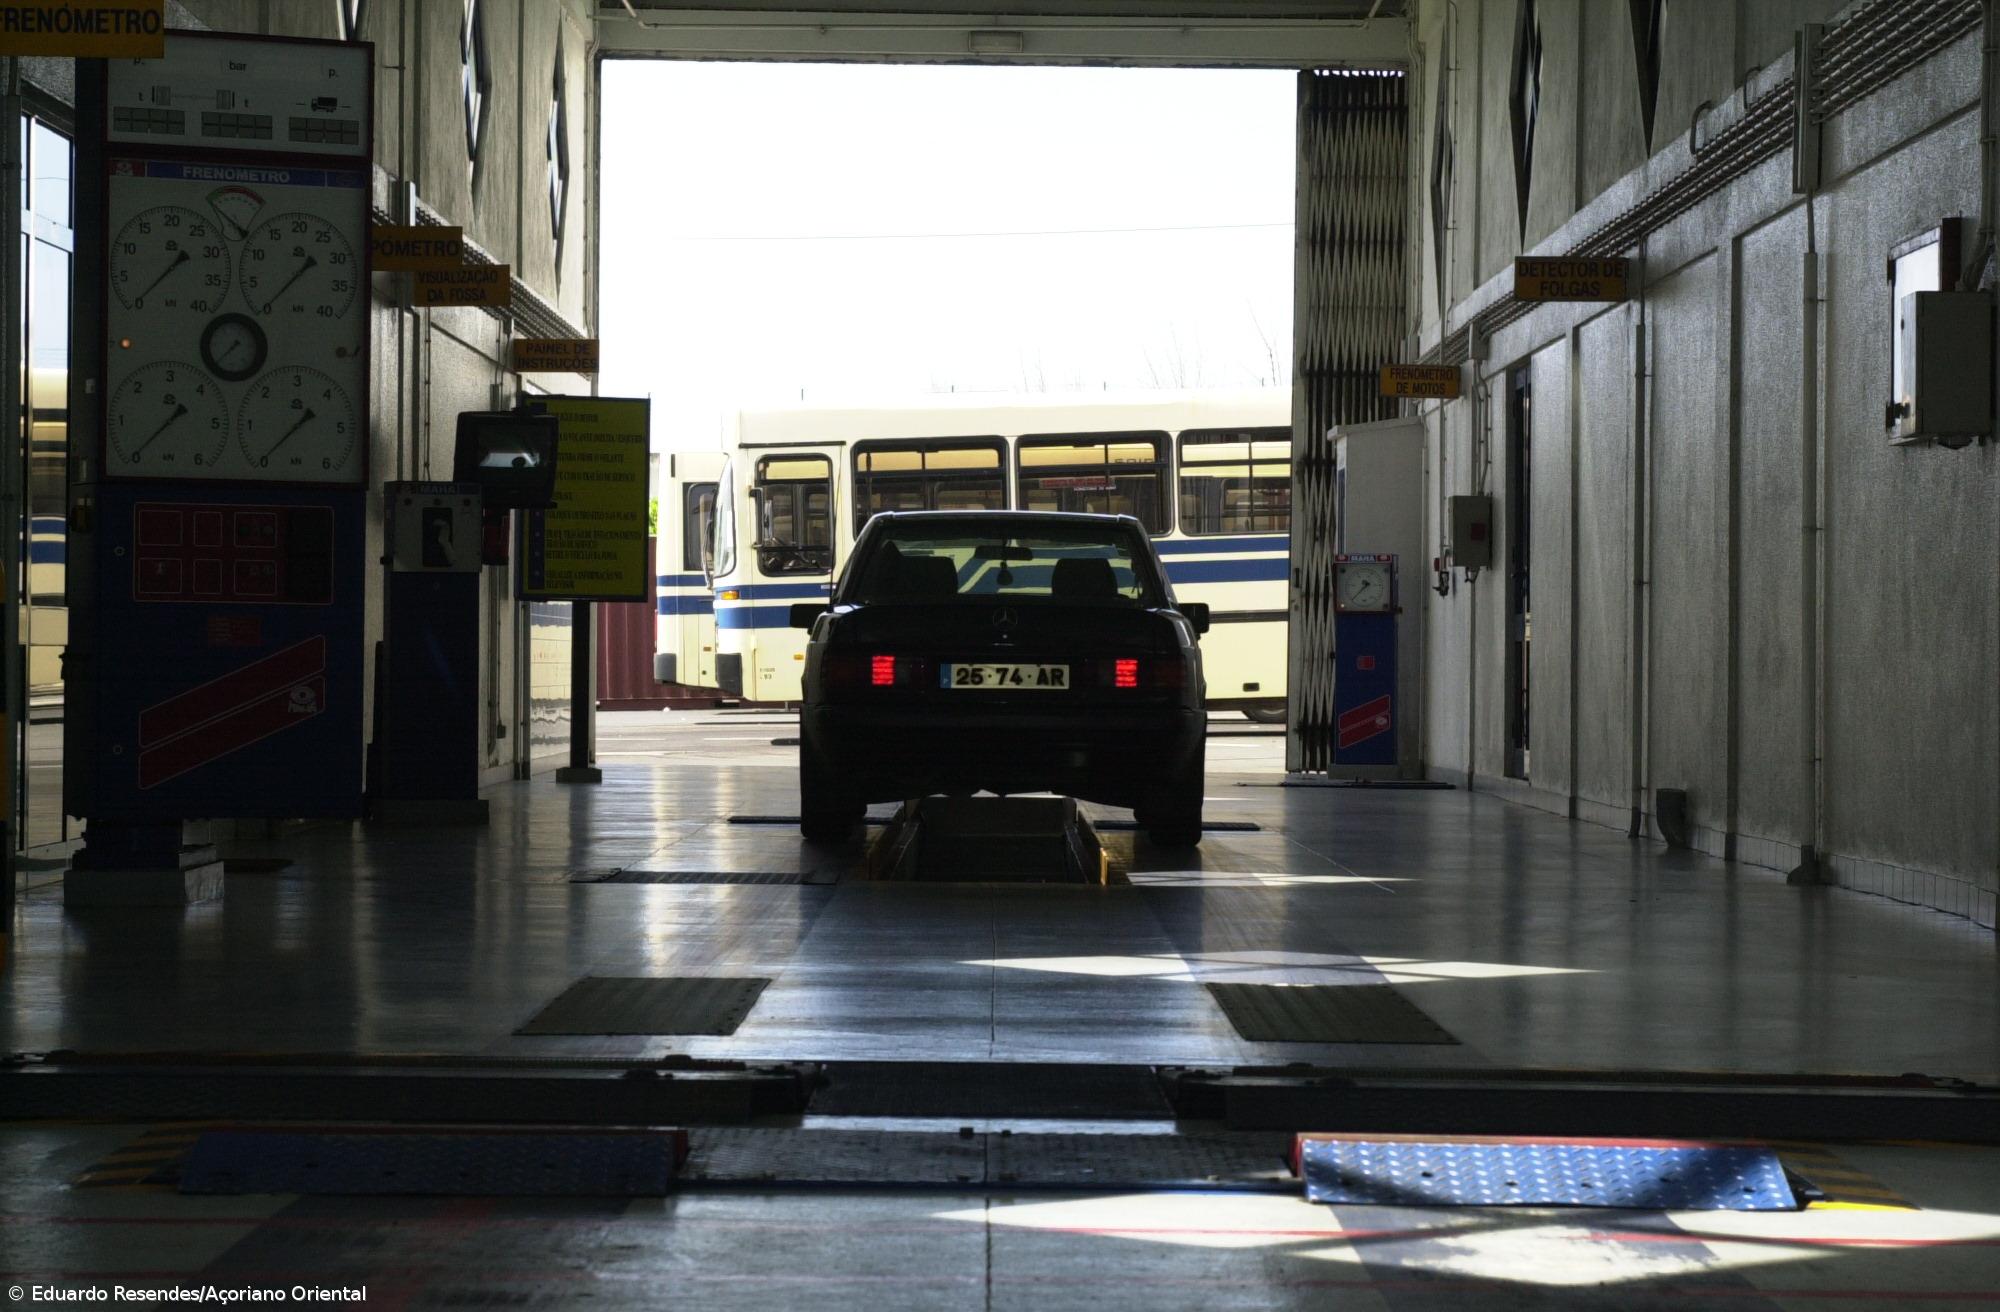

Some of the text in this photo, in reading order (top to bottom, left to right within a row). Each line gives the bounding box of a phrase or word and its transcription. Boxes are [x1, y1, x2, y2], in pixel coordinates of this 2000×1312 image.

[0, 4, 160, 33] RENÓMETRO
[230, 60, 246, 71] bar
[328, 68, 339, 78] p.
[183, 166, 290, 183] FRENOMETRO
[164, 215, 180, 226] 20
[139, 223, 150, 234] 15
[190, 226, 205, 236] 25
[292, 222, 307, 233] 20
[270, 229, 281, 240] 15
[316, 232, 331, 243] 25
[124, 243, 136, 254] 10
[203, 247, 219, 258] 30
[253, 250, 264, 260] 10
[330, 253, 346, 264] 30
[1518, 262, 1622, 278] DETECTOR DE
[120, 271, 128, 282] 5
[205, 275, 221, 286] 35
[418, 268, 498, 285] VISUALIZAÇÃO
[250, 277, 257, 288] 5
[332, 280, 348, 292] 35
[1540, 282, 1600, 296] FOLGAS
[427, 288, 487, 302] DA FOSSA
[135, 298, 143, 309] 0
[190, 301, 207, 312] 40
[263, 303, 271, 314] 0
[317, 306, 333, 316] 40
[526, 343, 591, 354] PAINEL DE
[166, 371, 174, 382] 3
[294, 375, 301, 386] 3
[134, 382, 142, 393] 2
[196, 384, 204, 394] 4
[262, 387, 270, 398] 2
[1396, 382, 1446, 395] DE MOTOS
[323, 389, 331, 400] 4
[119, 415, 124, 425] 1
[212, 418, 220, 429] 5
[248, 420, 252, 430] 1
[337, 422, 345, 433] 5
[132, 452, 140, 463] 0
[194, 454, 202, 465] 6
[260, 456, 268, 467] 0
[323, 458, 330, 469] 6
